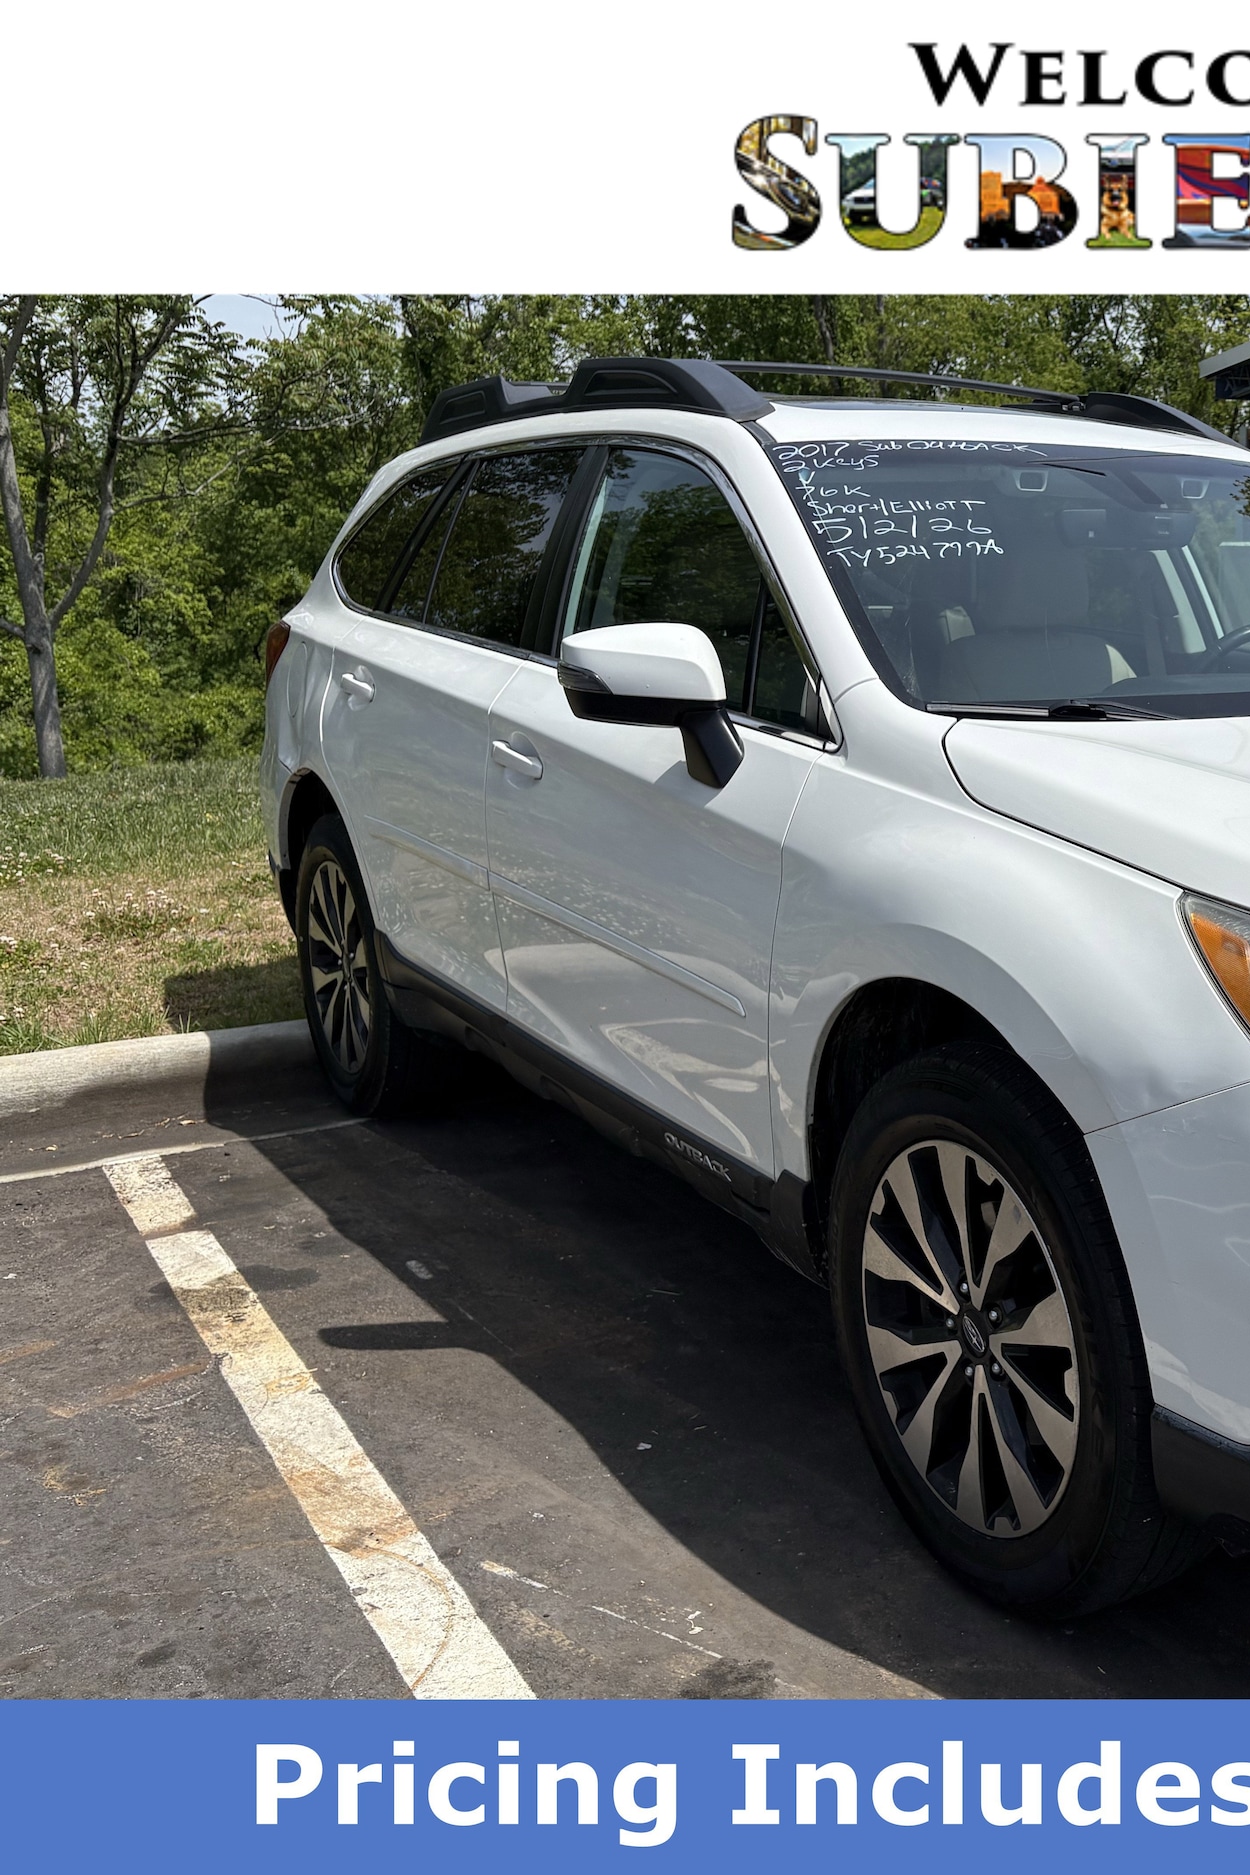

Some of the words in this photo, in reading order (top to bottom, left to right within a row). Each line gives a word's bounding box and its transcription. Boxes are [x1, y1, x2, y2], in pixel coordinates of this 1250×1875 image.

[772, 442, 850, 459] 2017
[782, 460, 810, 472] 2
[664, 1132, 731, 1182] OUTBACK
